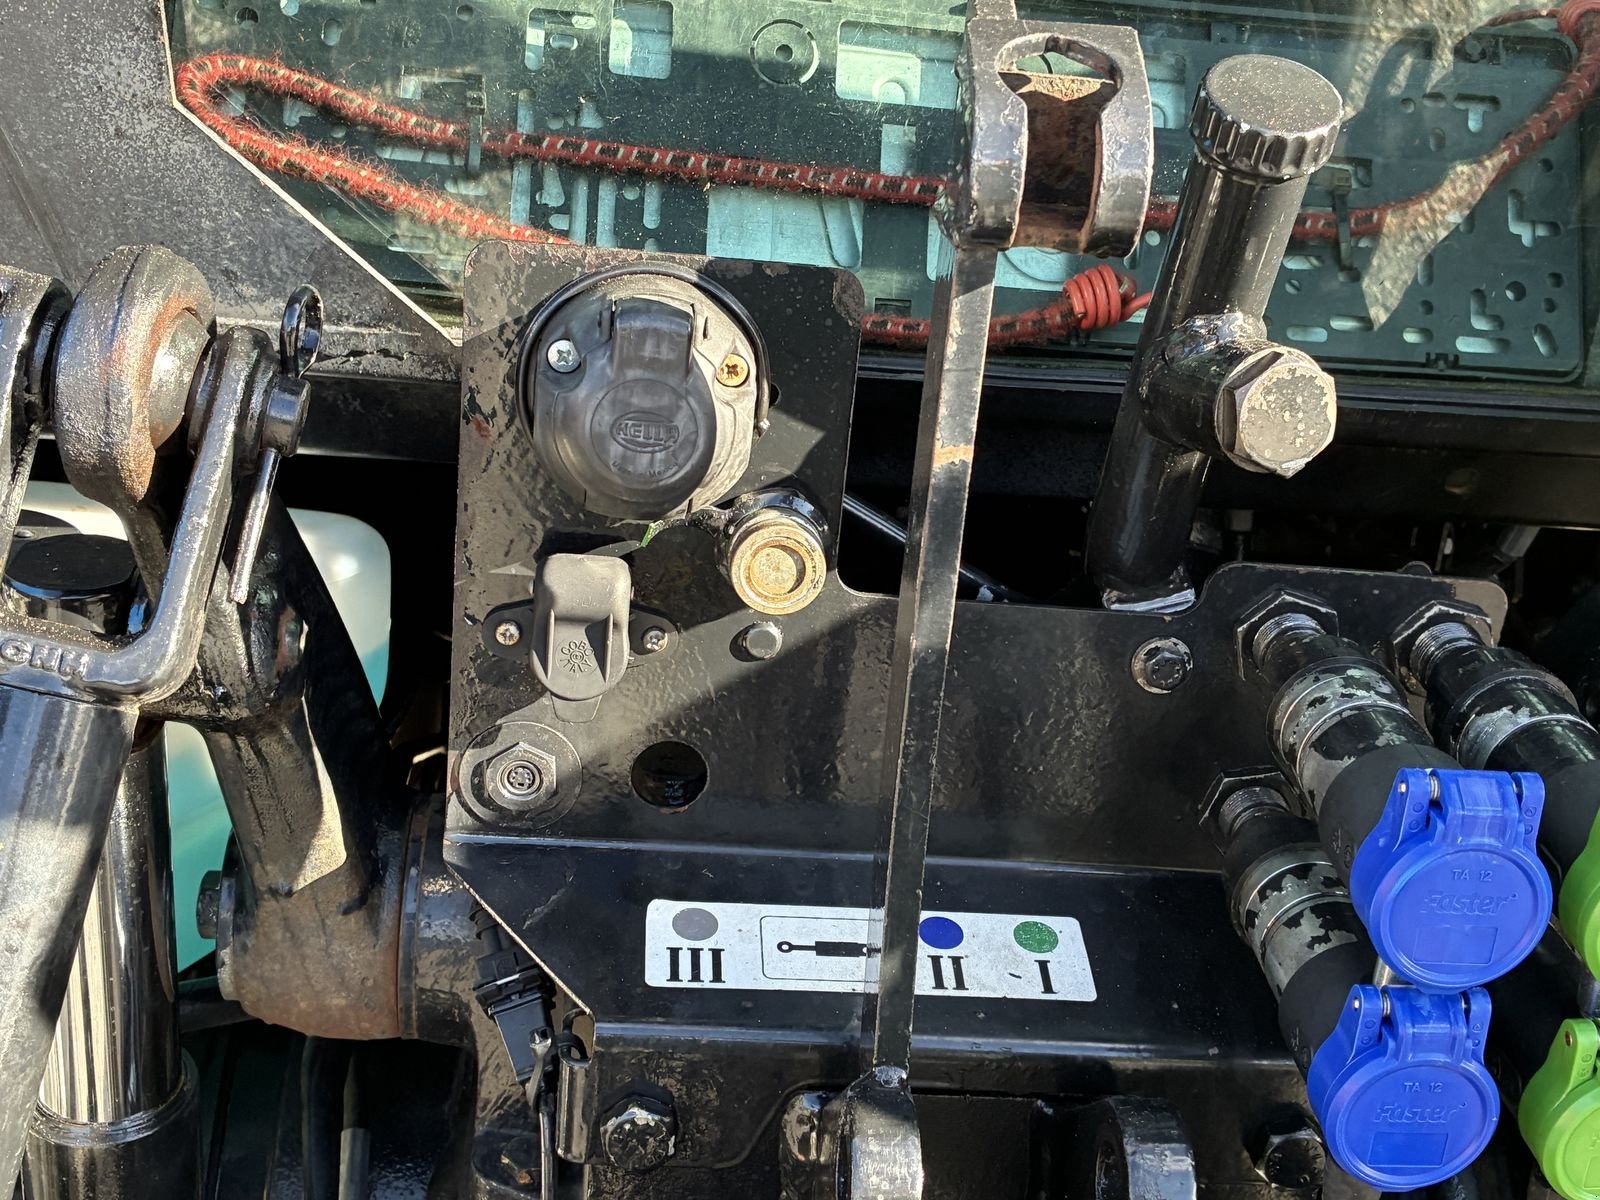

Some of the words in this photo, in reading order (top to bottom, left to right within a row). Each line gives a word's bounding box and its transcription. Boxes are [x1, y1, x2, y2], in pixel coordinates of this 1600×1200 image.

[616, 422, 680, 445] HELLA
[560, 640, 595, 657] COBO
[1452, 868, 1470, 881] TA
[1479, 869, 1494, 882] 12
[1420, 892, 1510, 916] Faster
[665, 946, 726, 984] III
[927, 954, 969, 991] II
[1034, 959, 1058, 995] I
[1403, 1082, 1421, 1094] TA
[1429, 1082, 1444, 1094] 12
[1374, 1103, 1458, 1124] Faster
